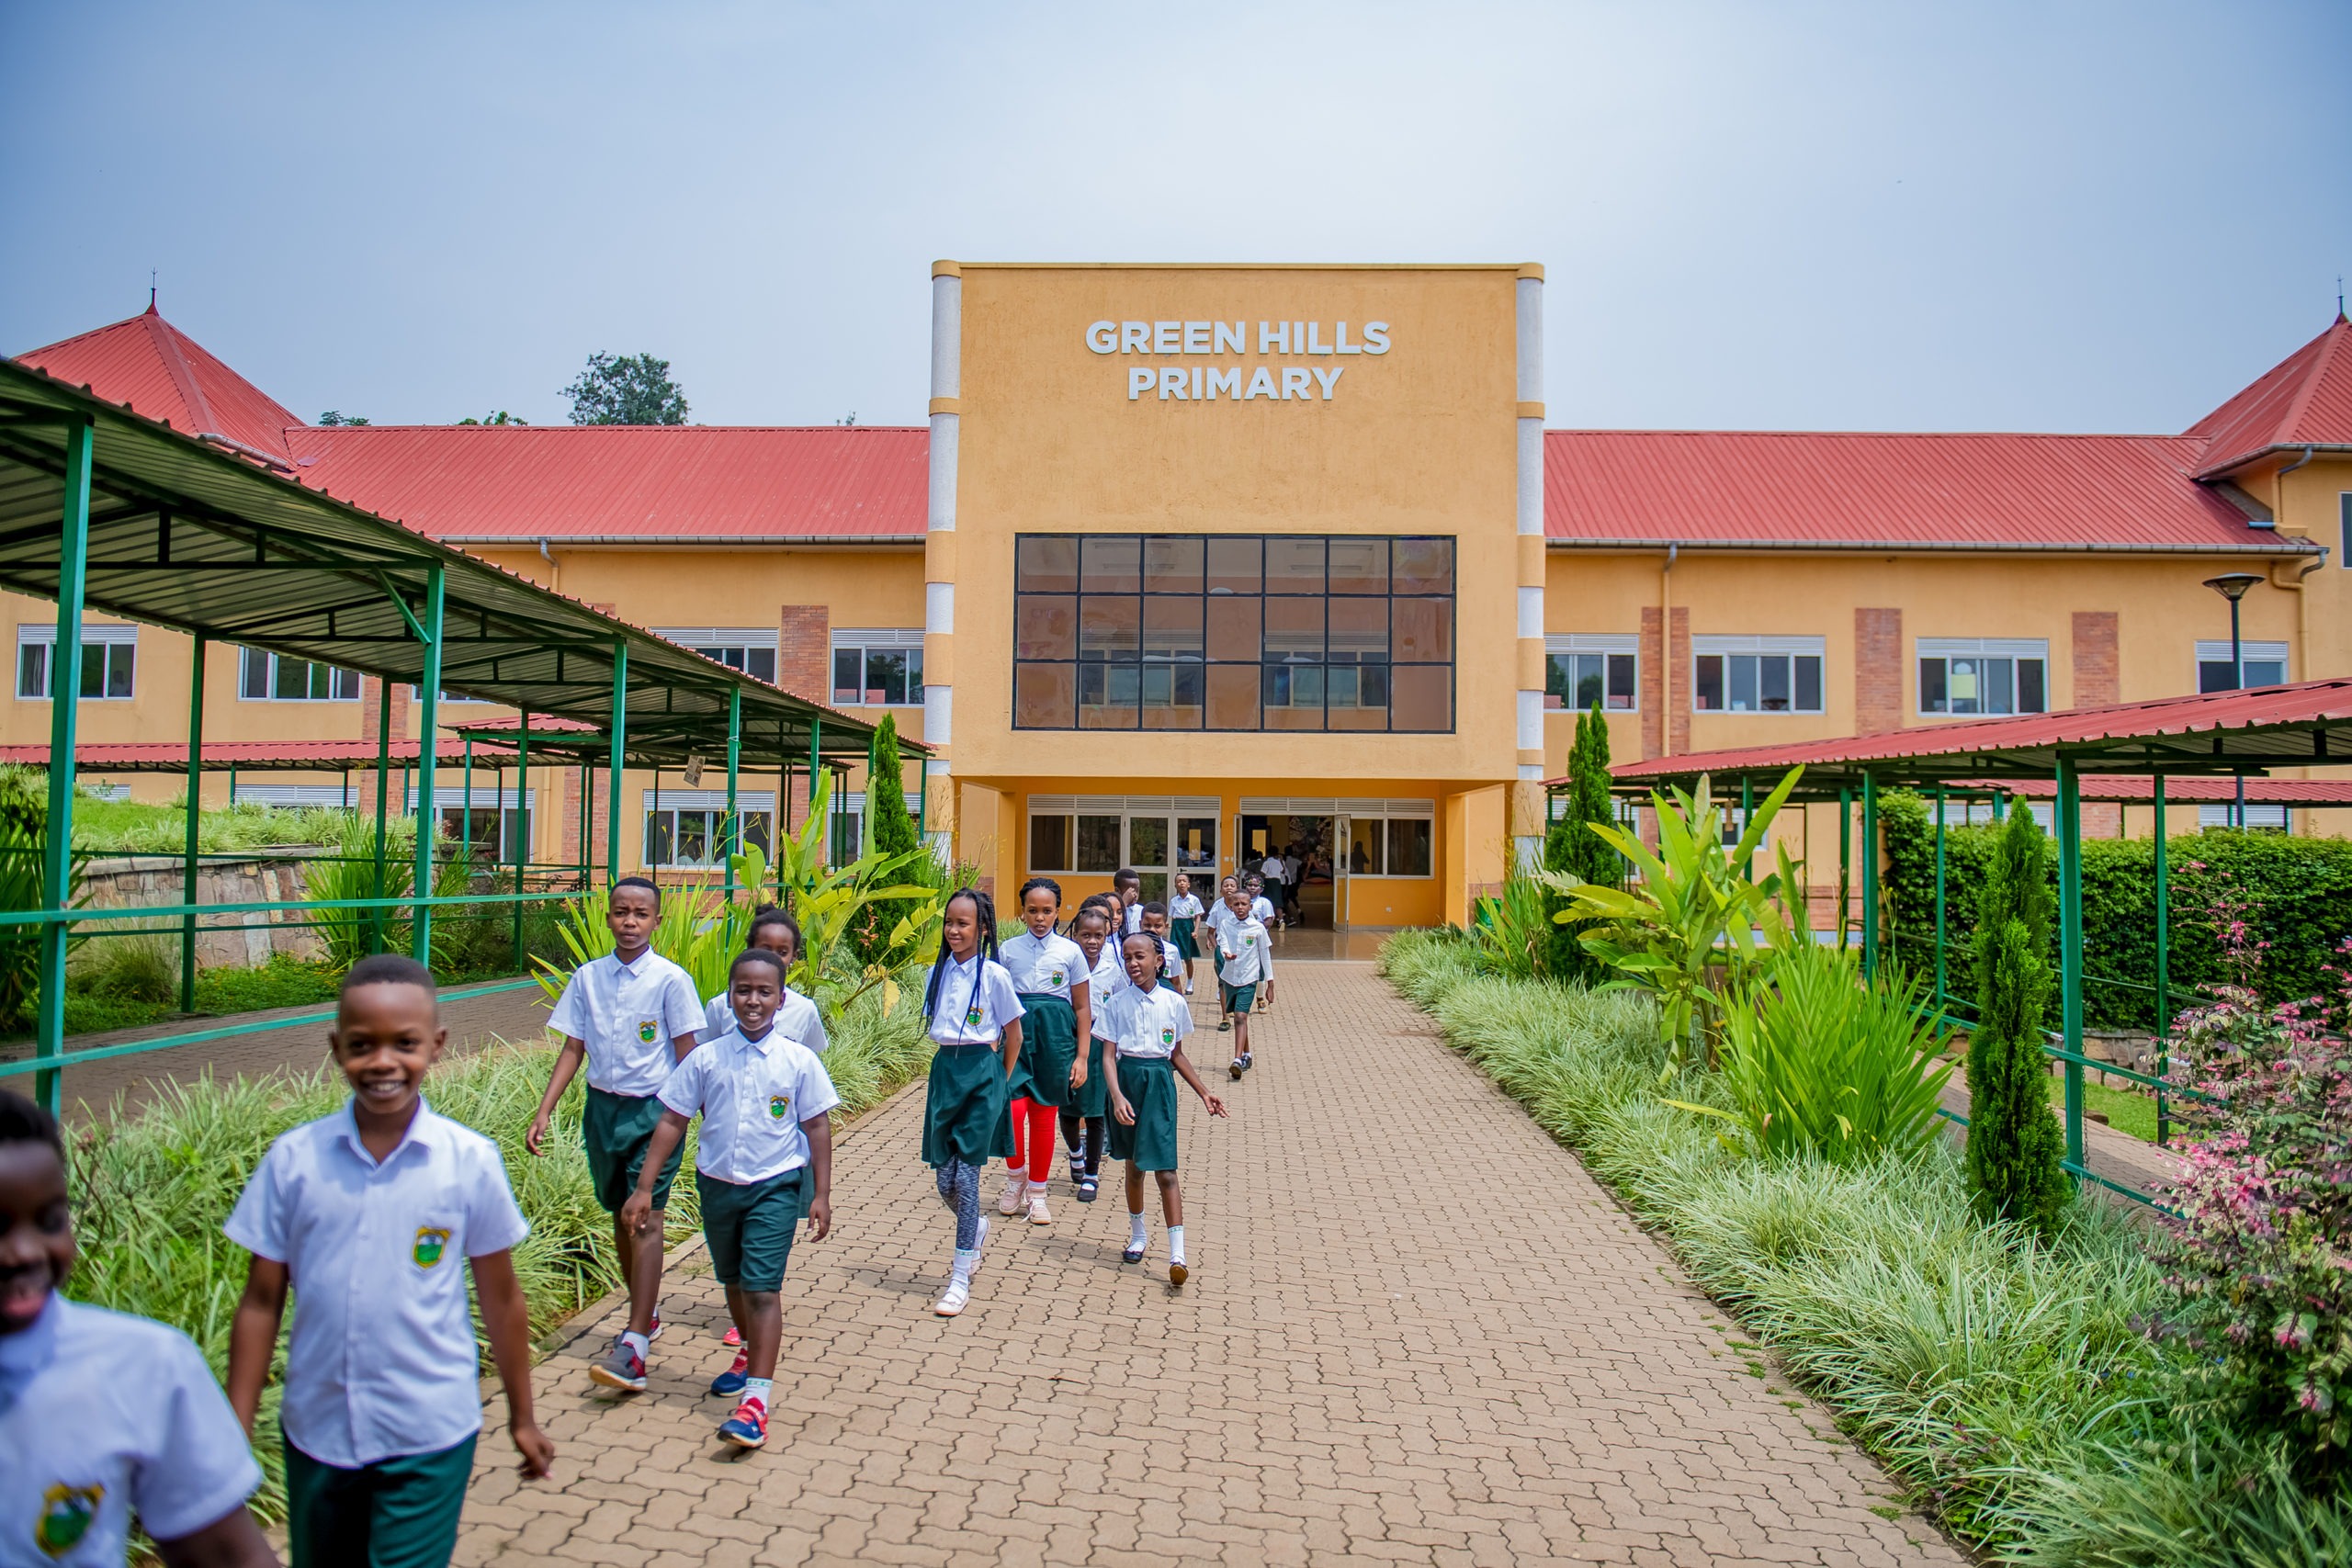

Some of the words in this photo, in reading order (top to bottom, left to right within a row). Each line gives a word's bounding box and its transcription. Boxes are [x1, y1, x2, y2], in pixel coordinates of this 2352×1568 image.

[1085, 321, 1246, 355] GREEN
[1259, 321, 1392, 355] HILLS
[1128, 367, 1345, 400] PRIMARY
